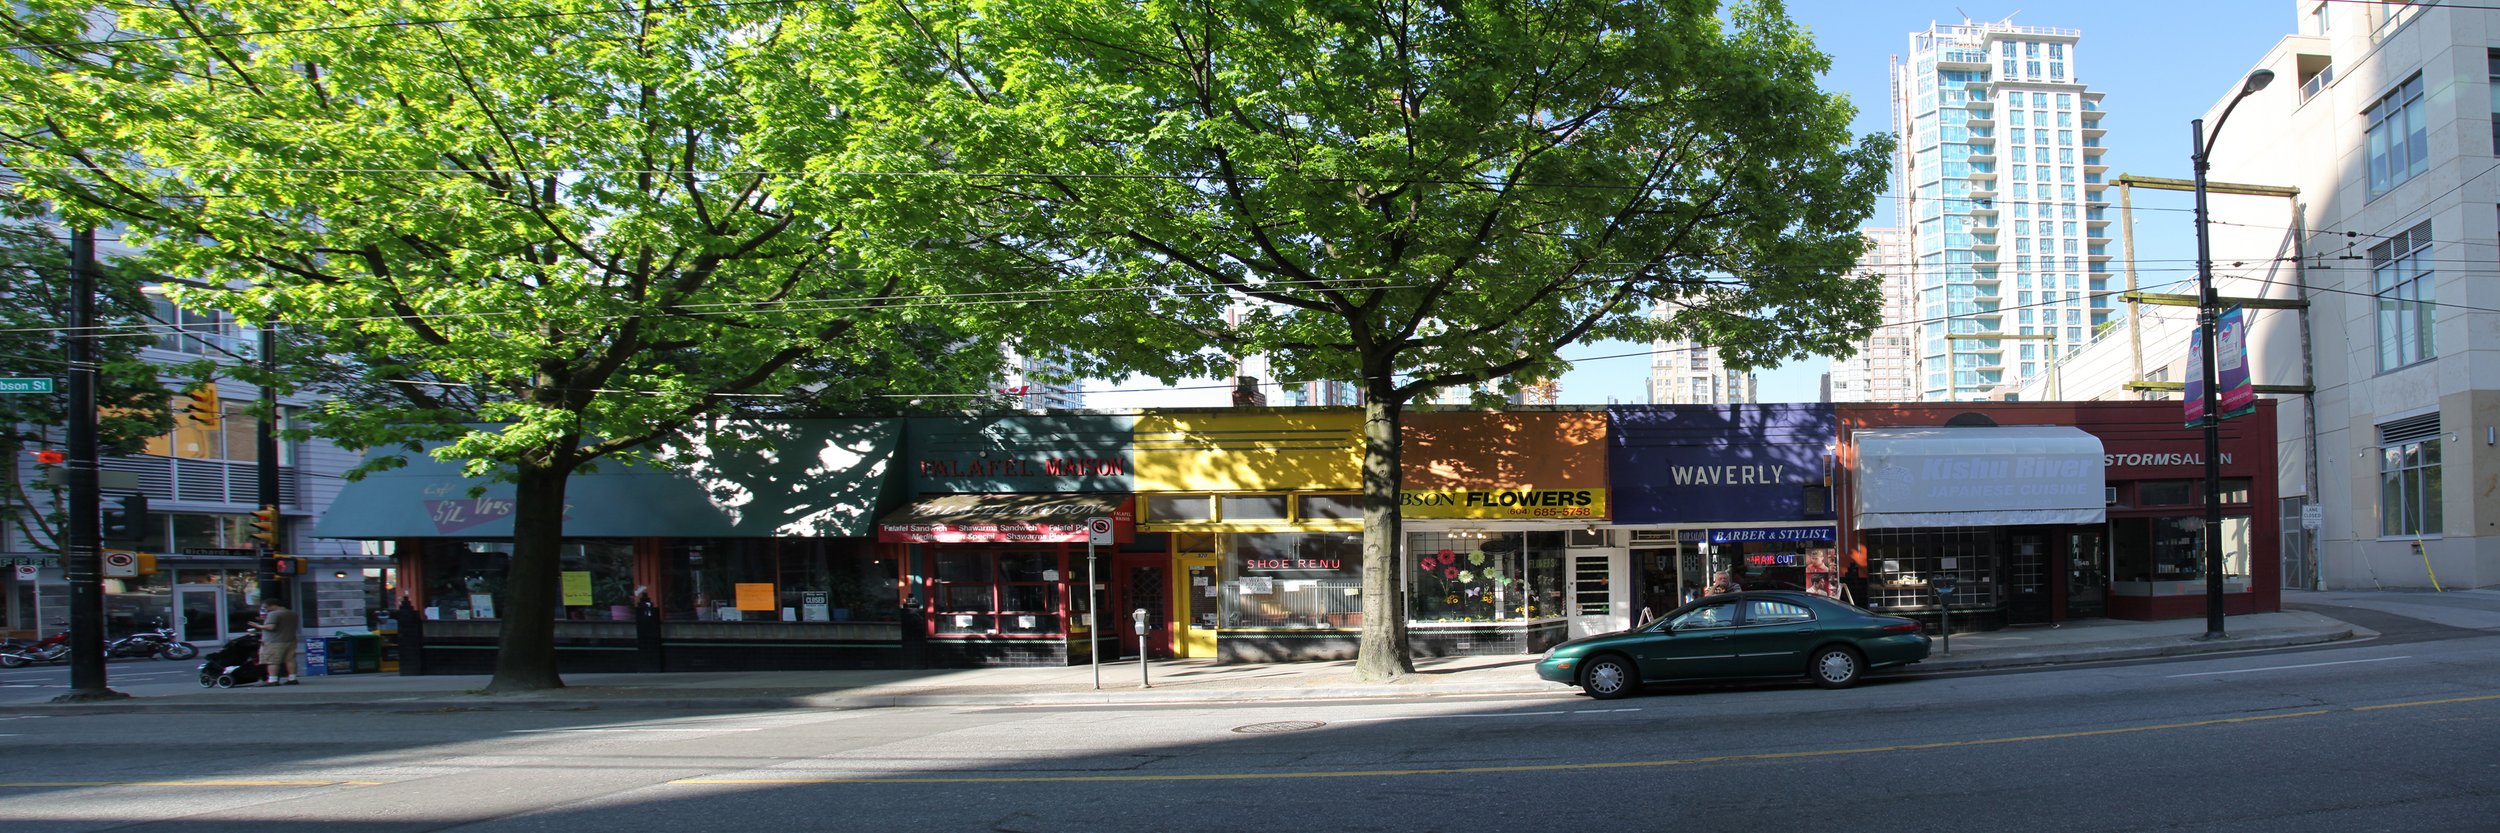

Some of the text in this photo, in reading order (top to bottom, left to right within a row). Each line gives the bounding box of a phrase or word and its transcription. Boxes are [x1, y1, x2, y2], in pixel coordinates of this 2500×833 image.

[0, 380, 46, 391] bson St
[2104, 452, 2232, 467] STORMSALN
[919, 458, 1125, 478] FALAFEL MAISON
[1921, 455, 2093, 481] Kishu River
[1671, 464, 1784, 486] WAVERLY
[1928, 483, 2088, 498] JAPANESE CUISINE
[1400, 490, 1592, 507] BSON FLOWERS
[908, 503, 1104, 517] FALAFEL MAISON
[1507, 507, 1591, 517] (604) 685-5758
[1000, 524, 1038, 532] Sandwich
[1049, 524, 1074, 532] Falafel
[1716, 528, 1830, 541] BARBER & STYLIST
[967, 533, 996, 541] Special
[1006, 532, 1047, 541] Shawarma
[1247, 558, 1341, 569] SHOE RENU
[1753, 554, 1794, 566] HAIR CUT
